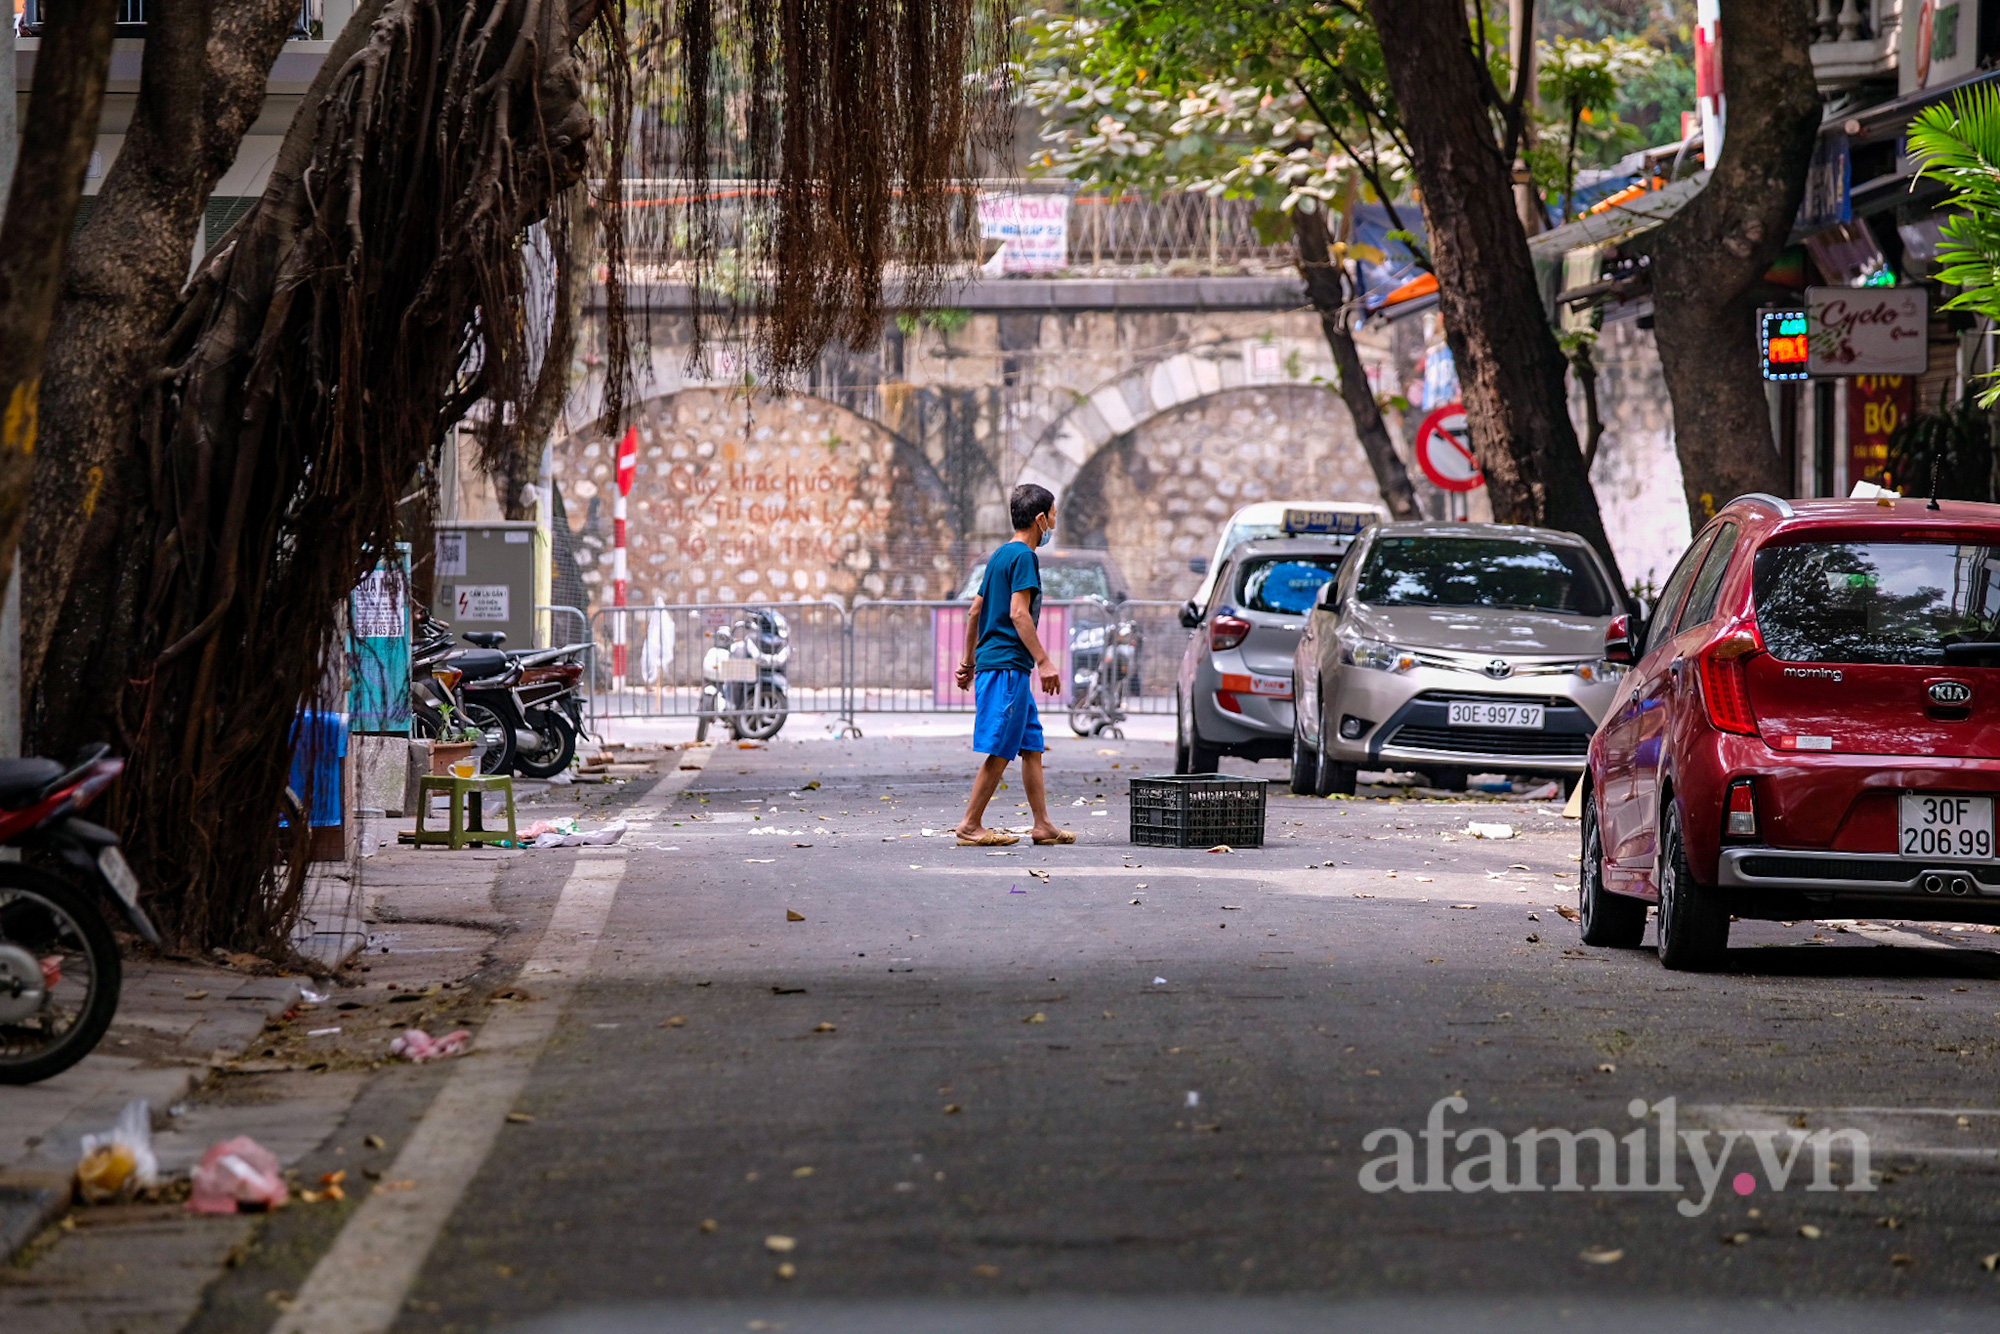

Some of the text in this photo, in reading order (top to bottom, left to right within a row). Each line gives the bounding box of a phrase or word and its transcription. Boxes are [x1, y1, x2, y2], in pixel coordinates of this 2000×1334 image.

[1820, 300, 1898, 335] Cyclo
[1783, 667, 1843, 682] morning
[1935, 687, 1963, 700] KIA
[1452, 704, 1540, 725] 30E-997.97
[1923, 798, 1970, 825] 30F
[1903, 827, 1991, 856] 206.99
